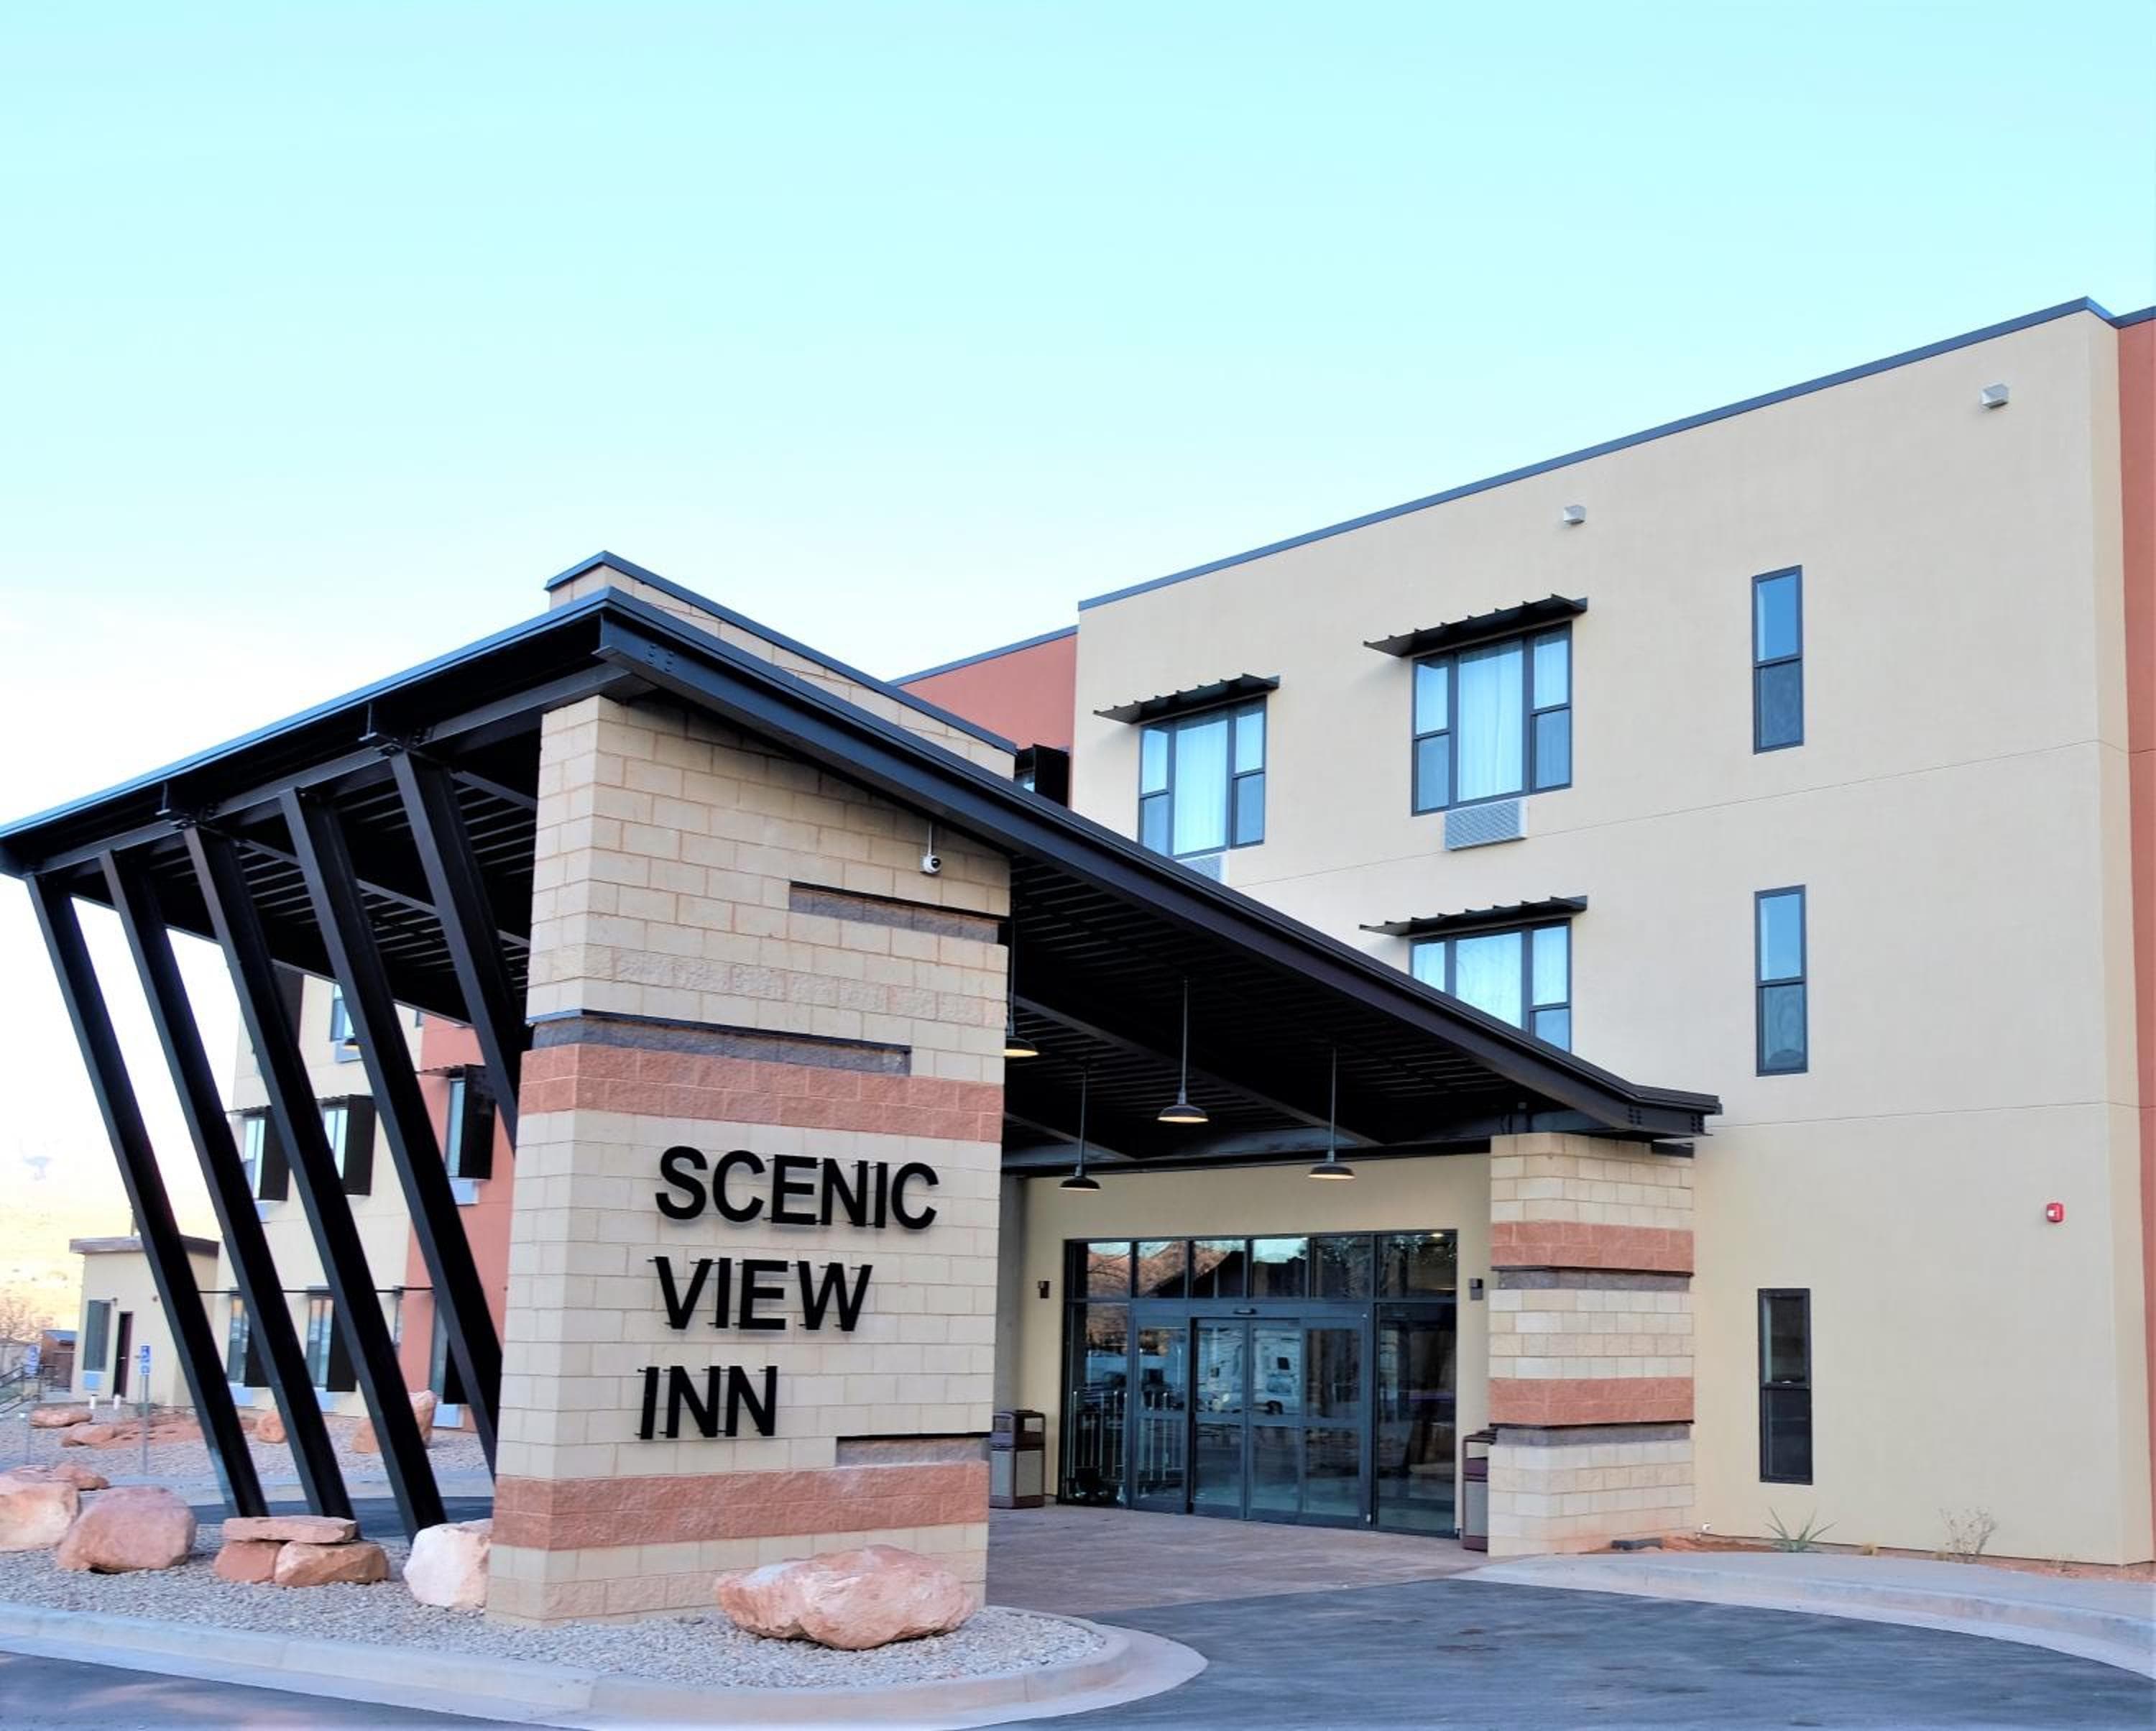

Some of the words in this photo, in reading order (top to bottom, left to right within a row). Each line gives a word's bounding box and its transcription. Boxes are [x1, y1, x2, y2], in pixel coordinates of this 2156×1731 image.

[655, 1146, 939, 1230] SCENIC
[654, 1257, 873, 1332] VIEW
[639, 1366, 778, 1440] INN
